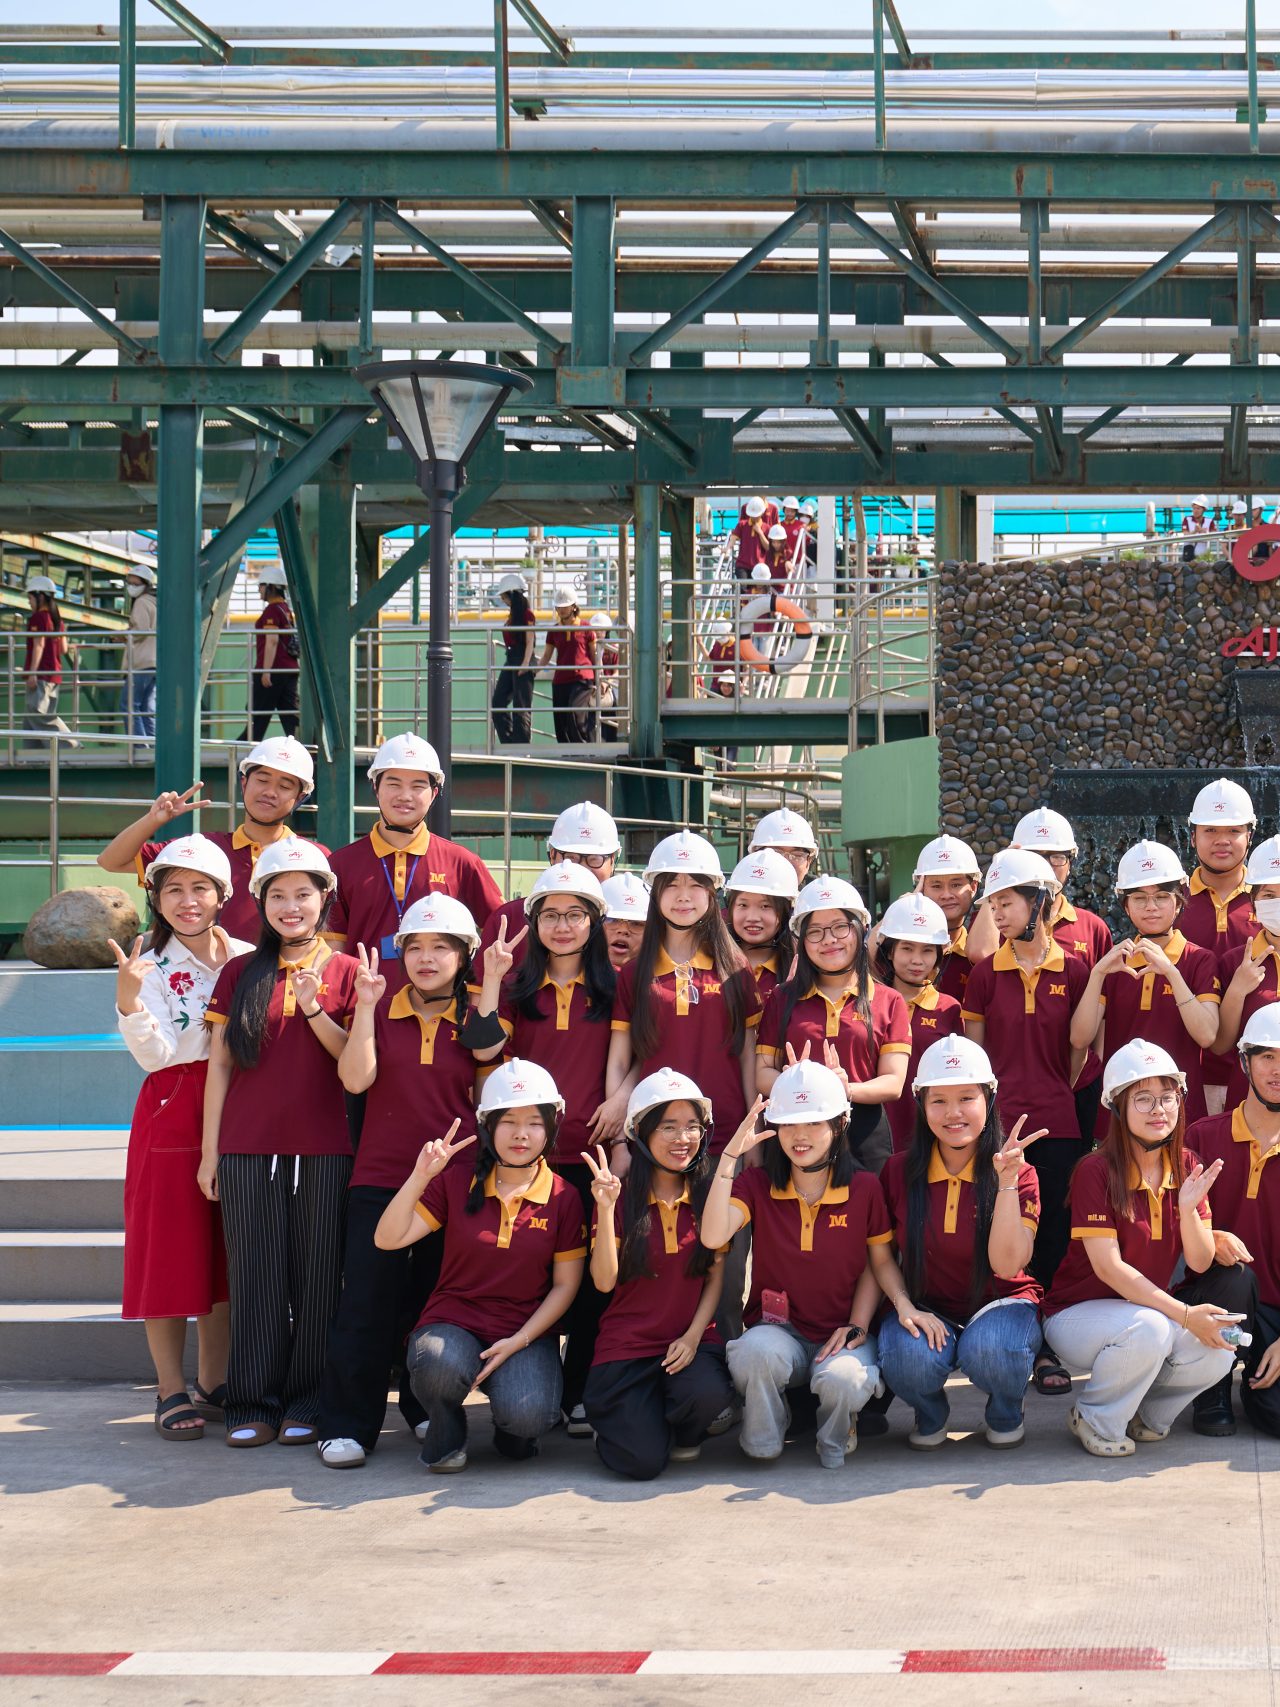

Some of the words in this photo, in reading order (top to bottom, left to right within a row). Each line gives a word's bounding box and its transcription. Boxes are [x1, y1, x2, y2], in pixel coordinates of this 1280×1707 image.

[430, 872, 446, 884] M
[1074, 941, 1087, 952] M
[704, 983, 720, 994] M
[1049, 984, 1065, 996] M
[921, 1017, 937, 1028] M
[529, 1217, 548, 1231] M
[829, 1215, 847, 1227] M
